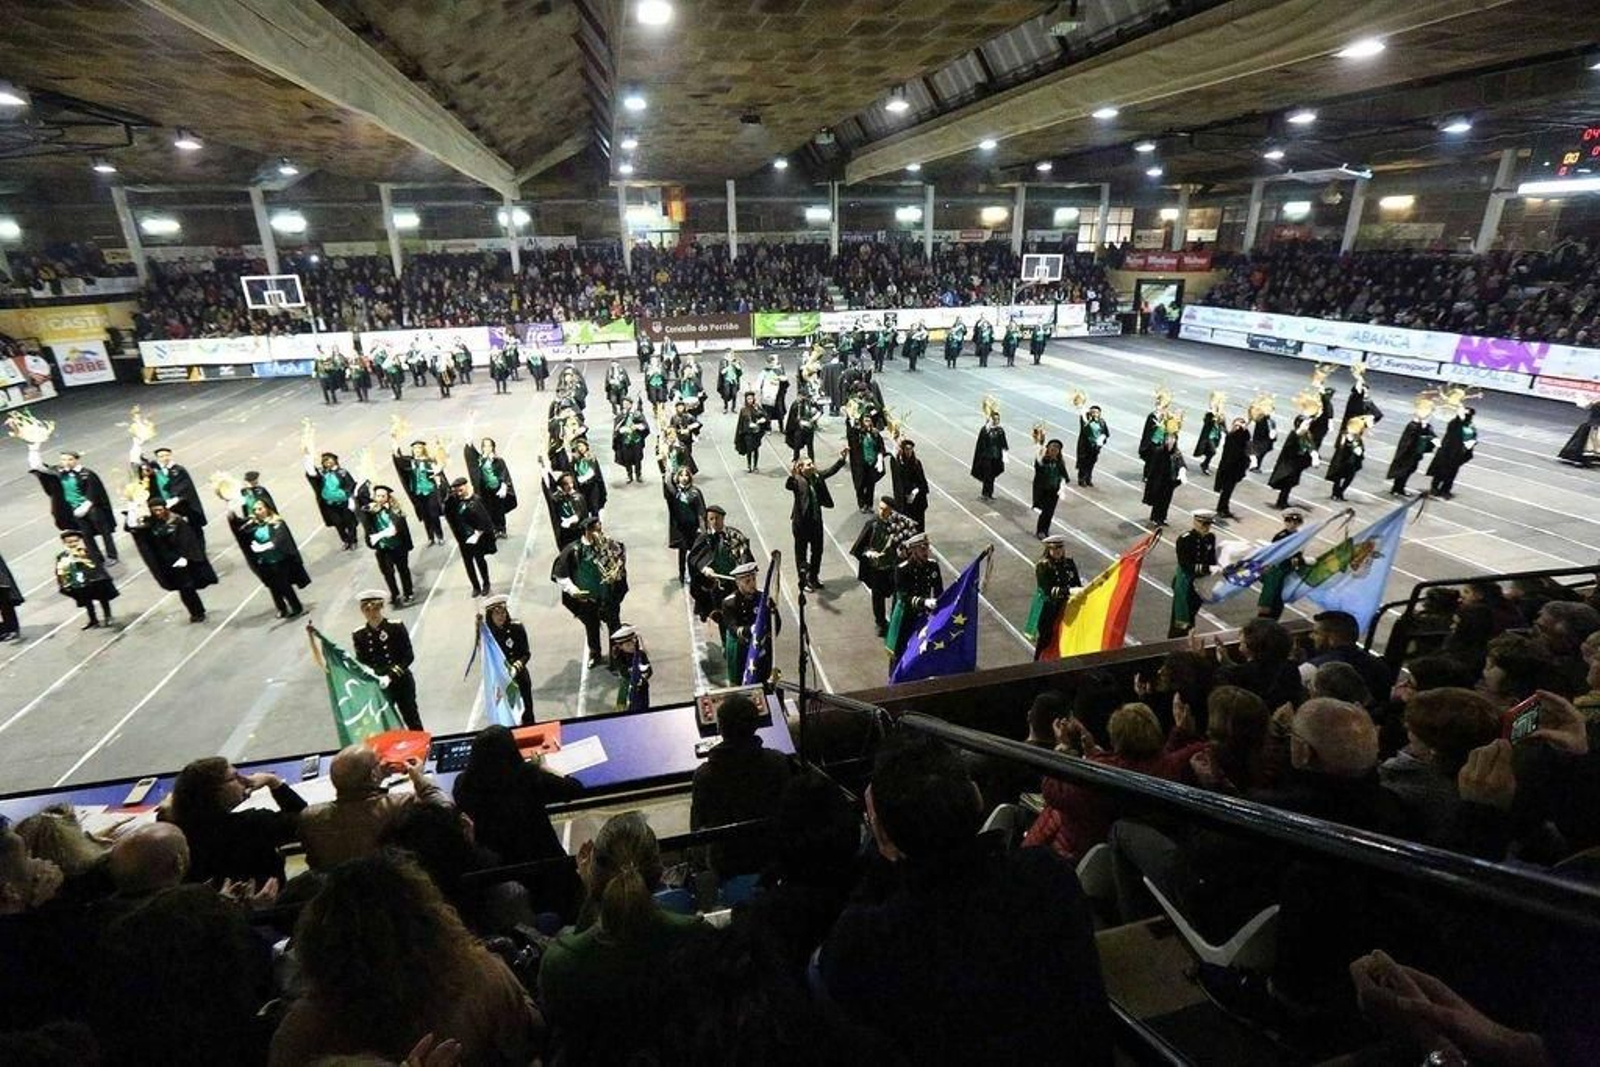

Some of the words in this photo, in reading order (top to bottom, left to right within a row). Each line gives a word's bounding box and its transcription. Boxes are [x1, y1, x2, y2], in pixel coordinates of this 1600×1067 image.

[664, 323, 697, 333] Concello
[698, 322, 709, 332] do
[62, 360, 107, 375] ORBE
